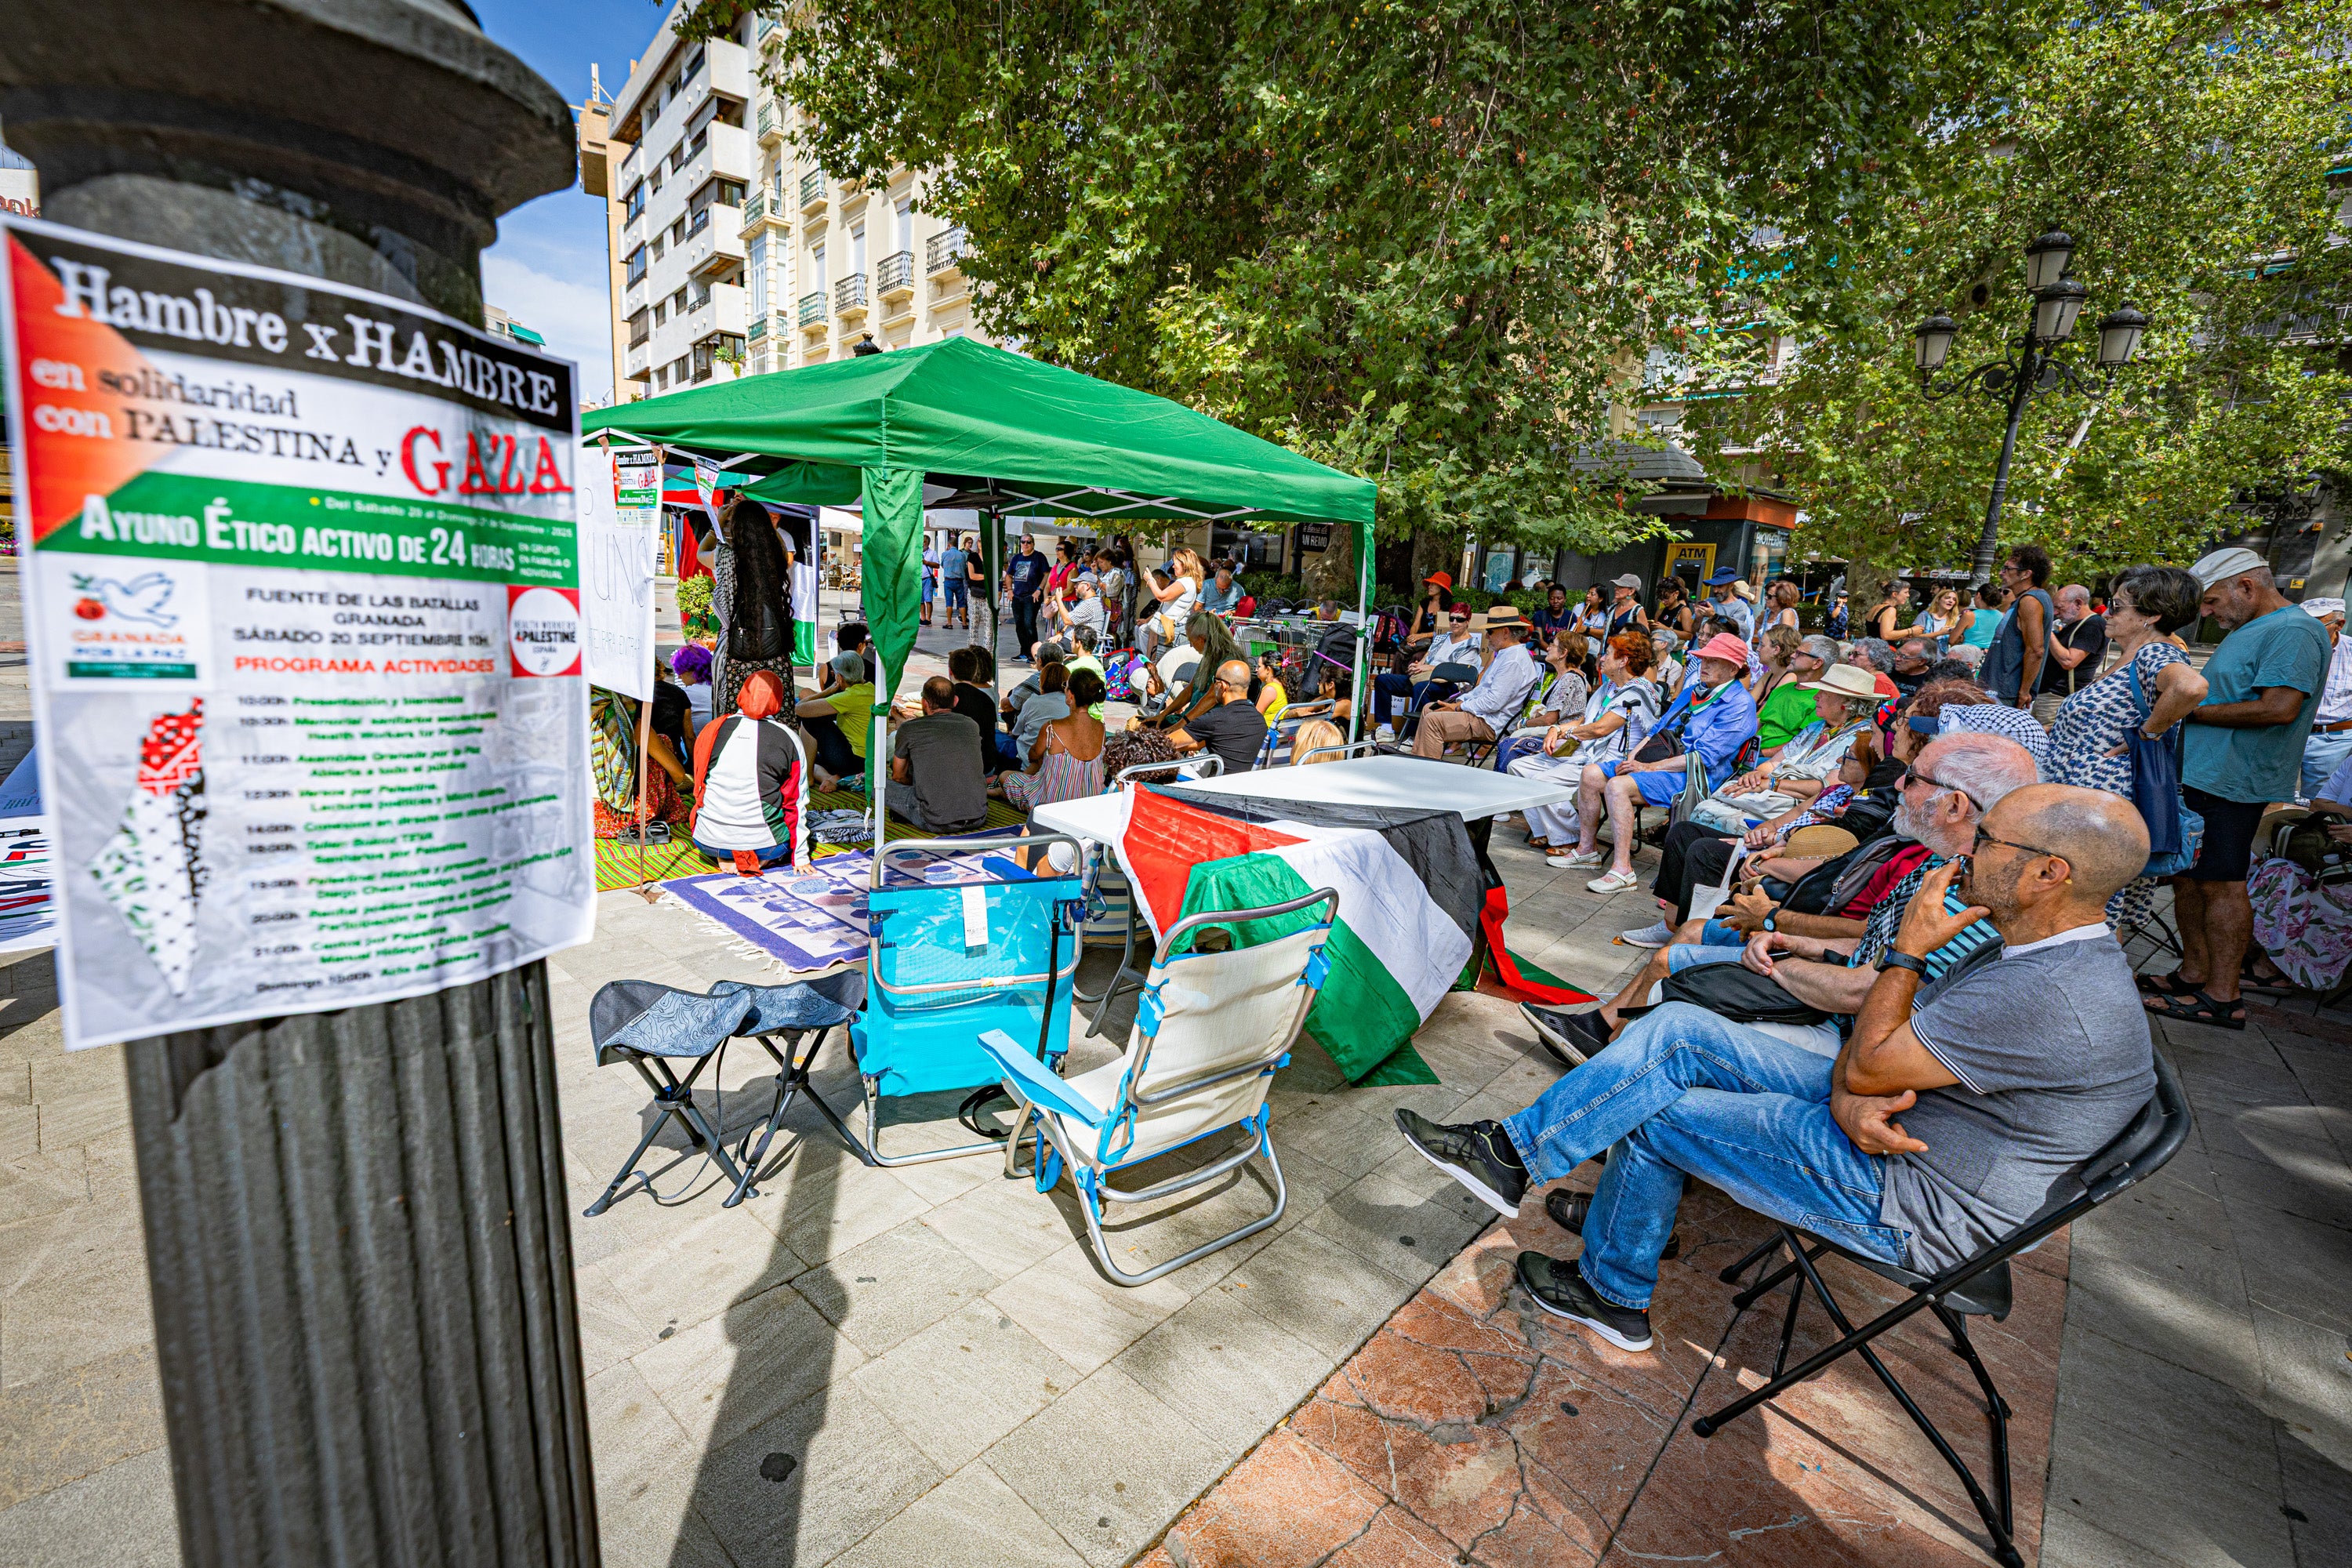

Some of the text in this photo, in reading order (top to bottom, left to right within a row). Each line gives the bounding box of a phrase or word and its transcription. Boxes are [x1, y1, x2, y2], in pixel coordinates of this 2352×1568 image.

[50, 256, 558, 417] Hambre x HAMBRE
[30, 358, 299, 418] en solidaridad
[33, 404, 575, 497] con PALESTINA y GAZA
[79, 494, 201, 548] AYUNO
[203, 496, 297, 554] ÉTICO
[301, 527, 393, 562] ACTIVO
[397, 535, 427, 564] DE
[429, 527, 467, 567] 24
[1310, 535, 1327, 547] REMO
[1755, 532, 1783, 547] BIOTHERM
[1679, 548, 1706, 558] ATM
[245, 588, 480, 612] FUENTE DE LAS BATALLAS
[332, 612, 426, 627] GRANADA
[233, 626, 325, 644] SÁBADO
[330, 633, 352, 645] 20
[357, 633, 463, 648] SEPTIEMBRE
[234, 655, 496, 674] PROGRAMA ACTIVIDADES
